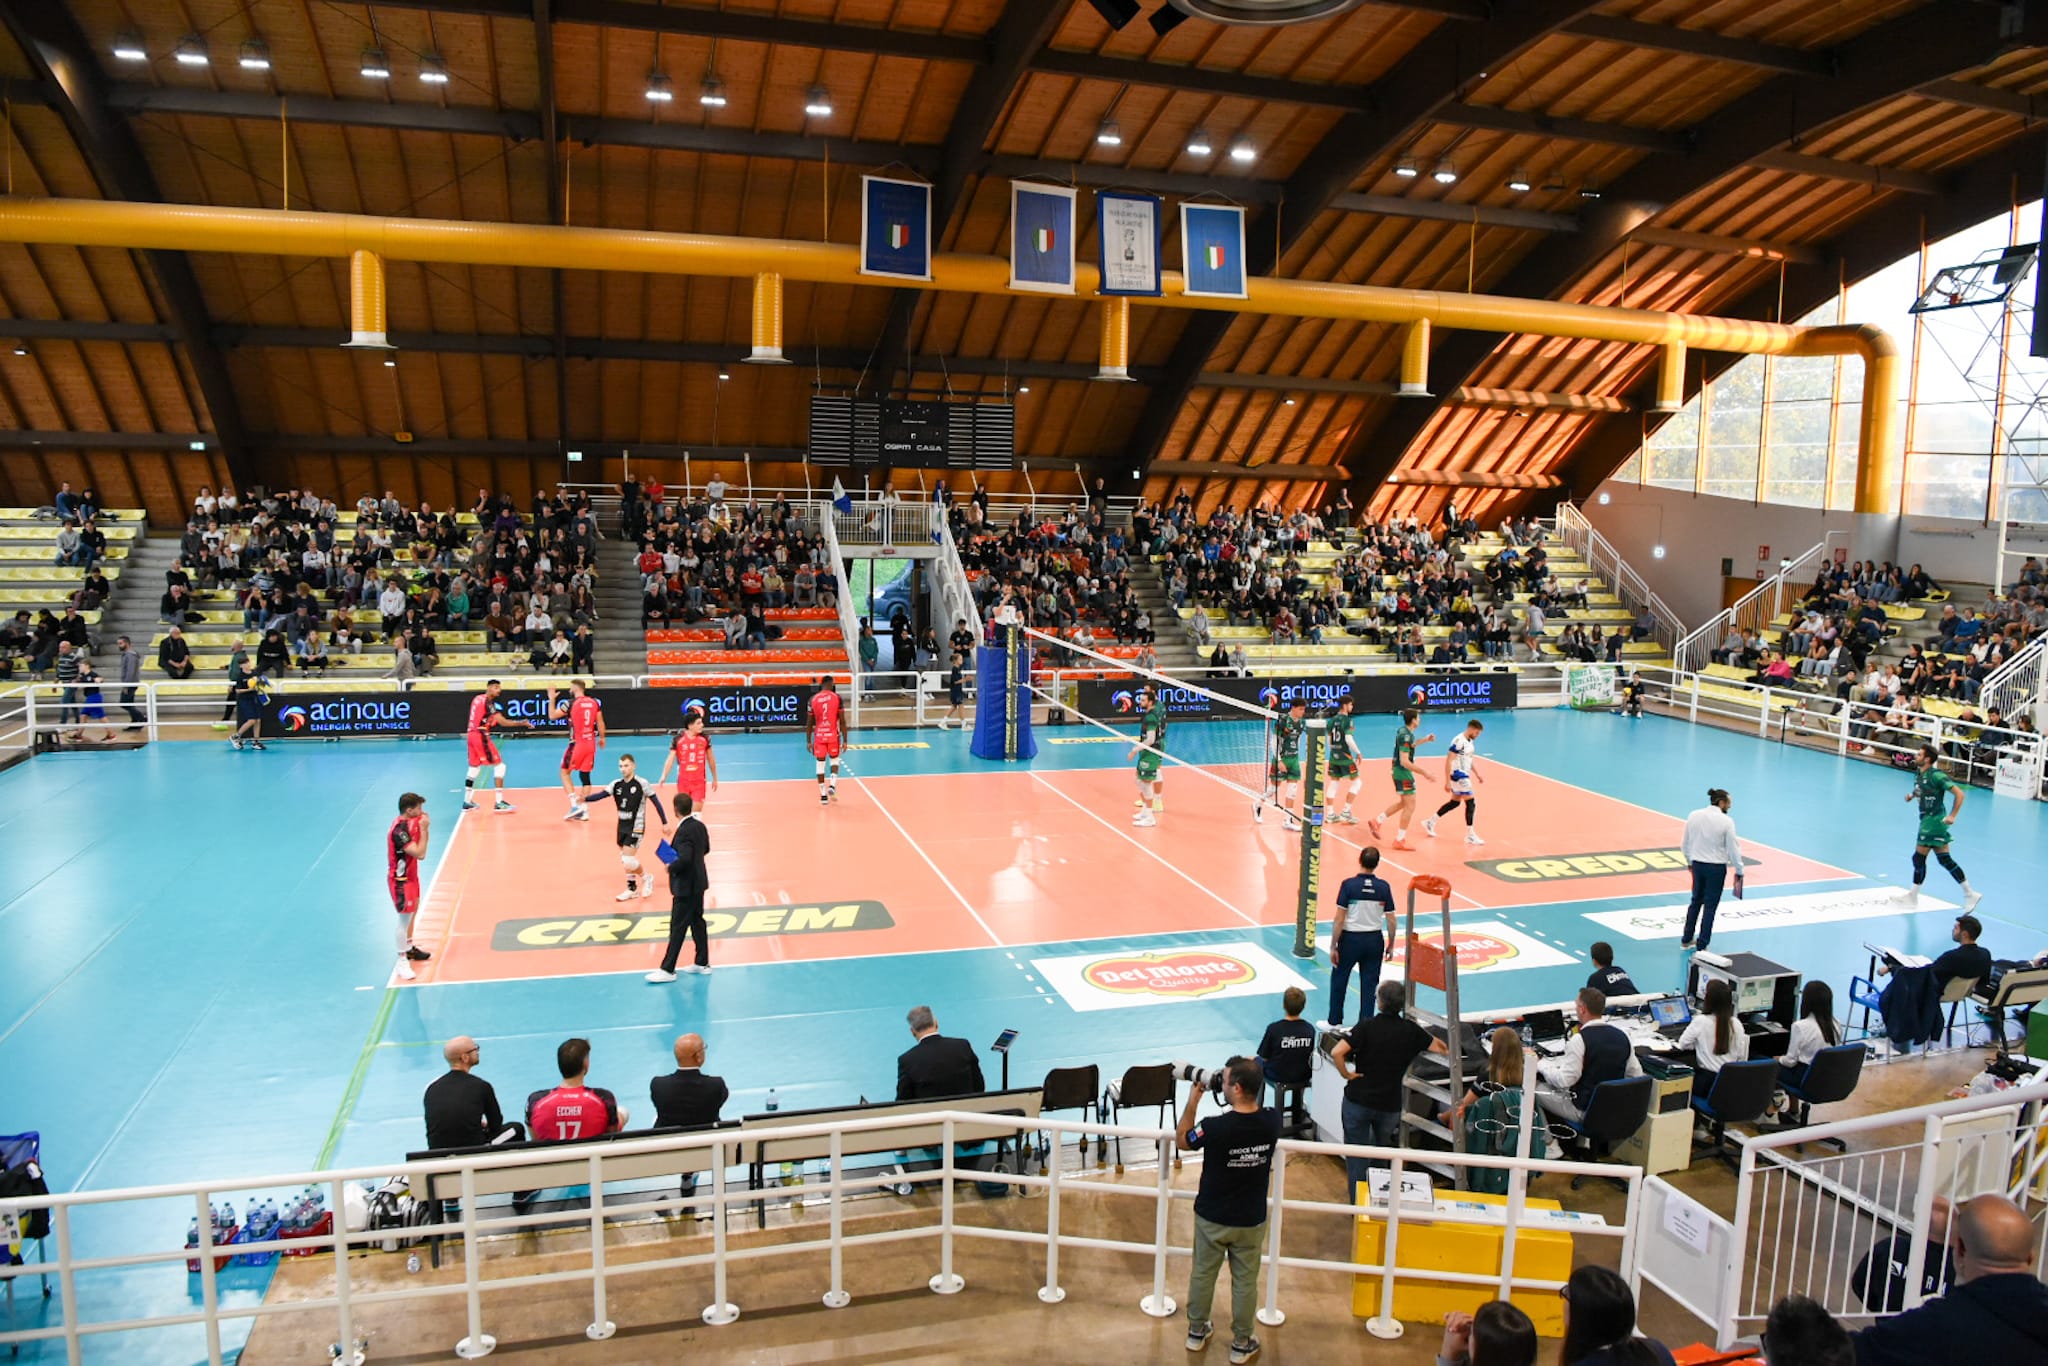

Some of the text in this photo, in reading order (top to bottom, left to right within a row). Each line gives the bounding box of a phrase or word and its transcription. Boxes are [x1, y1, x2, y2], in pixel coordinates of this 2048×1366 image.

[1281, 680, 1350, 700] acinque
[1427, 677, 1492, 697] acinque
[310, 697, 411, 720] acinque
[709, 690, 798, 713] acinque
[310, 723, 352, 731] ENERGIA
[354, 722, 373, 730] CHE
[1315, 735, 1326, 783] BANCA
[1308, 847, 1320, 894] BANCA
[1496, 850, 1690, 879] CREDE
[1304, 901, 1317, 948] CREDEM
[1096, 962, 1240, 983] Del Monte
[1149, 976, 1209, 988] Quality
[557, 1106, 582, 1117] ECCHER
[556, 1120, 582, 1140] 17
